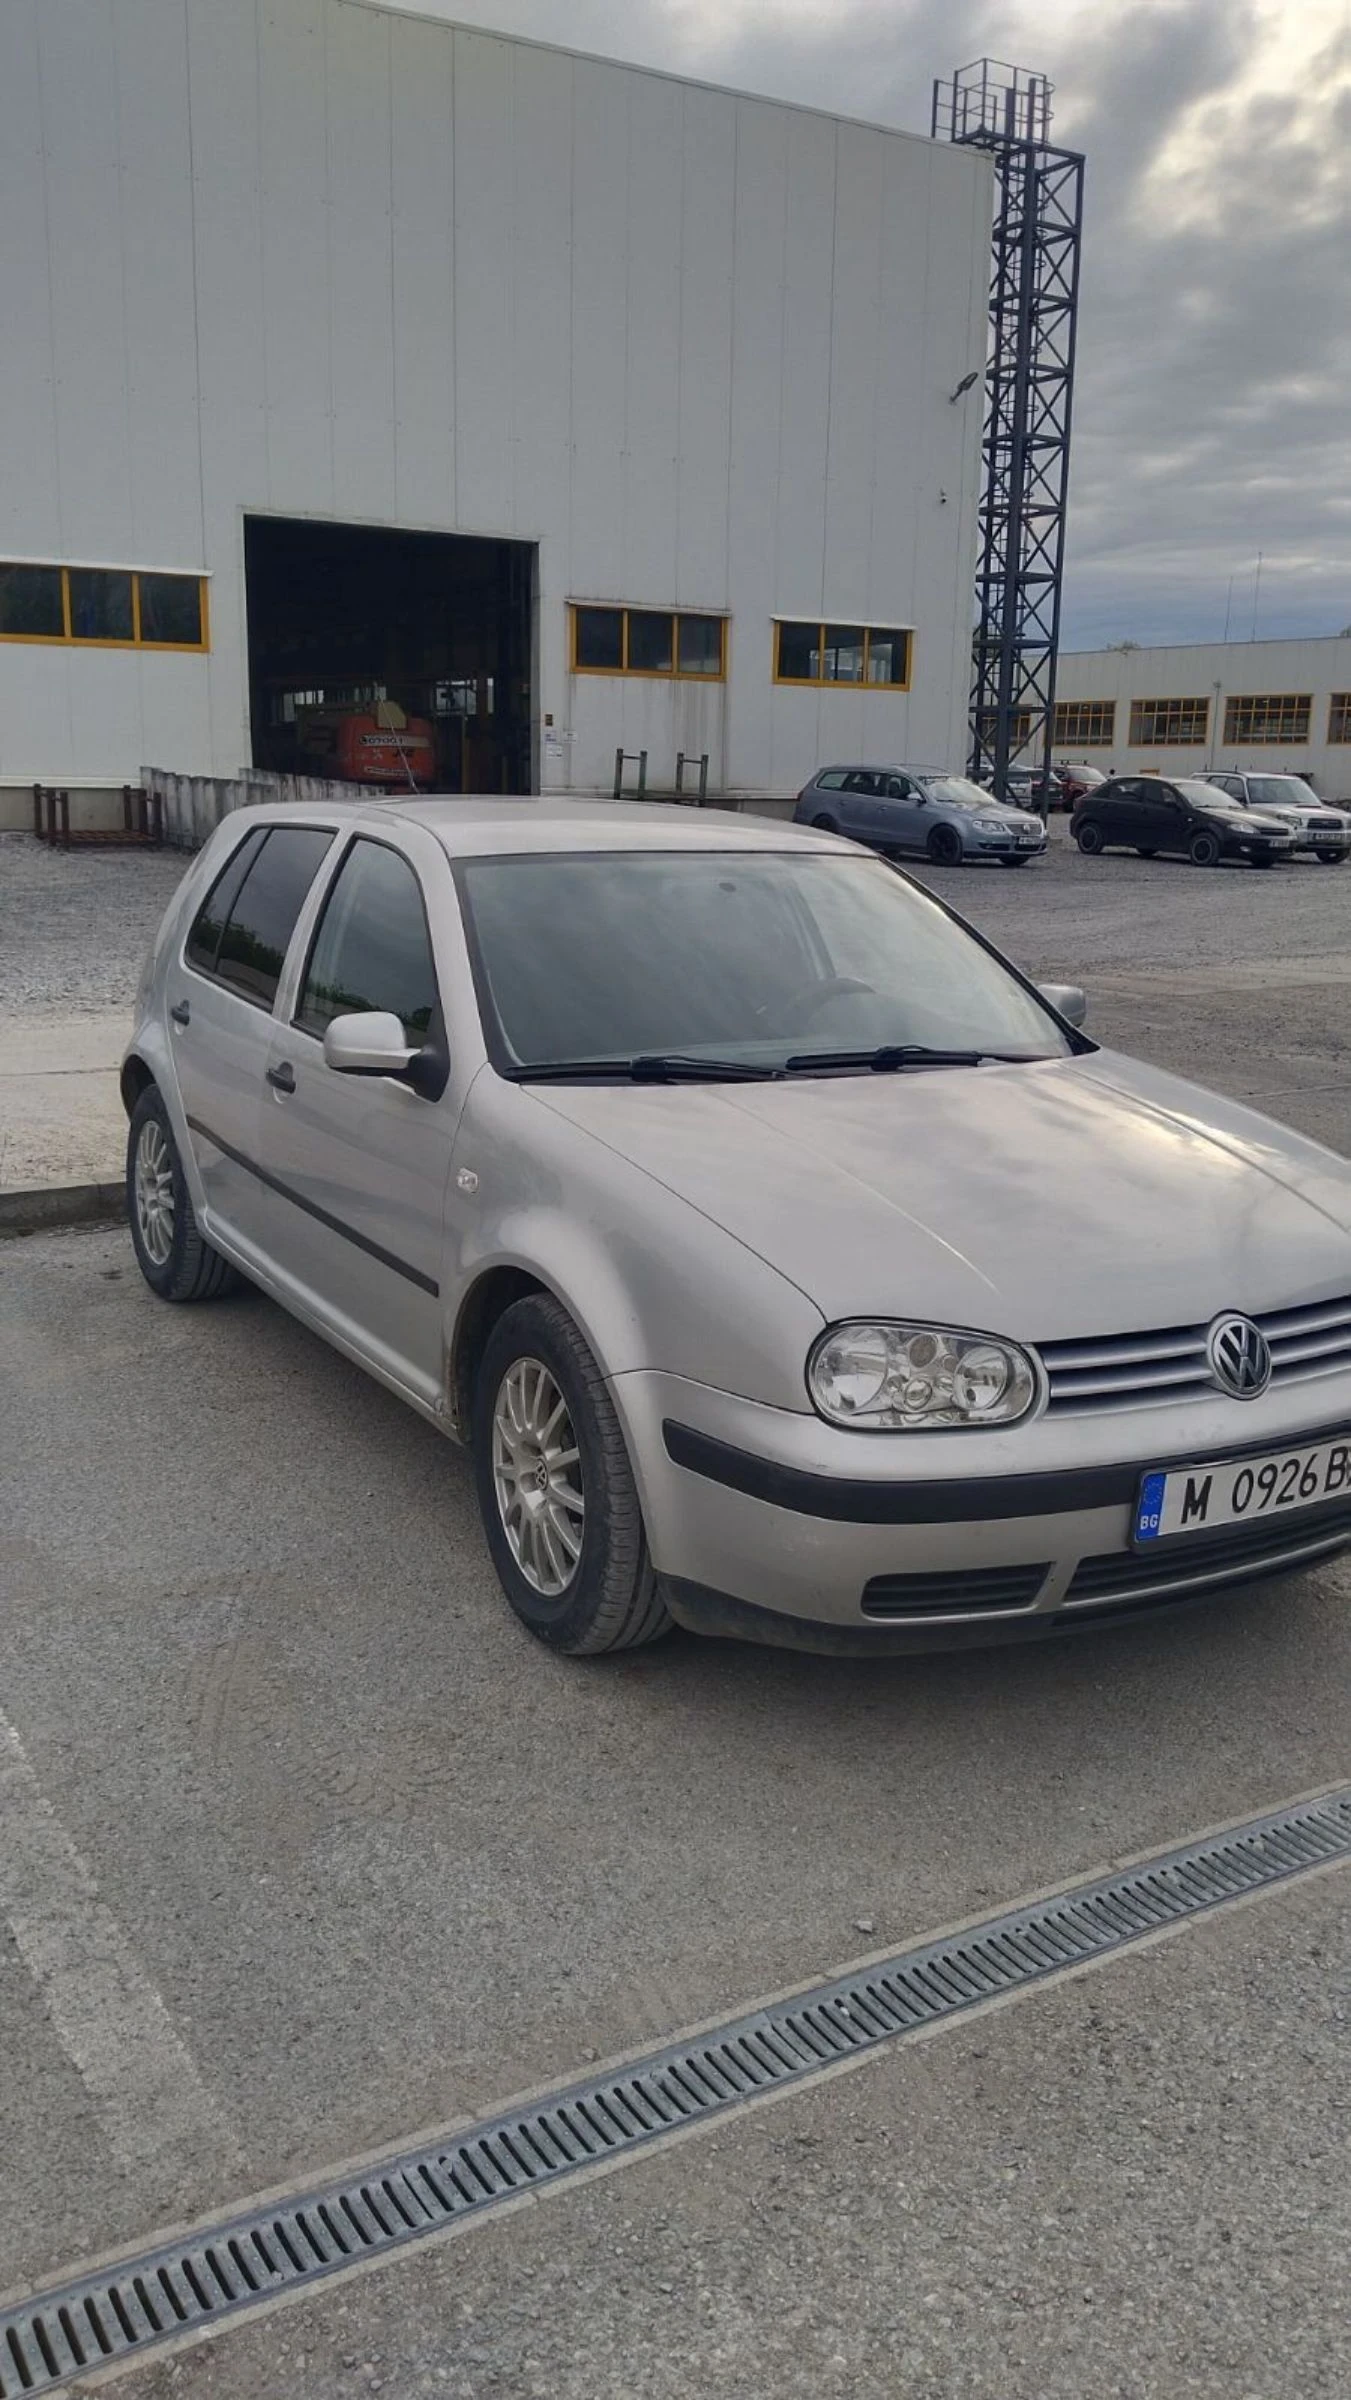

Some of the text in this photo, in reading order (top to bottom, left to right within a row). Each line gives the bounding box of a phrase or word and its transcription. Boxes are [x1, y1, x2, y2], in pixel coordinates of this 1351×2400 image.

[1180, 1445, 1351, 1524] M 0926 B
[1139, 1515, 1159, 1530] BG
